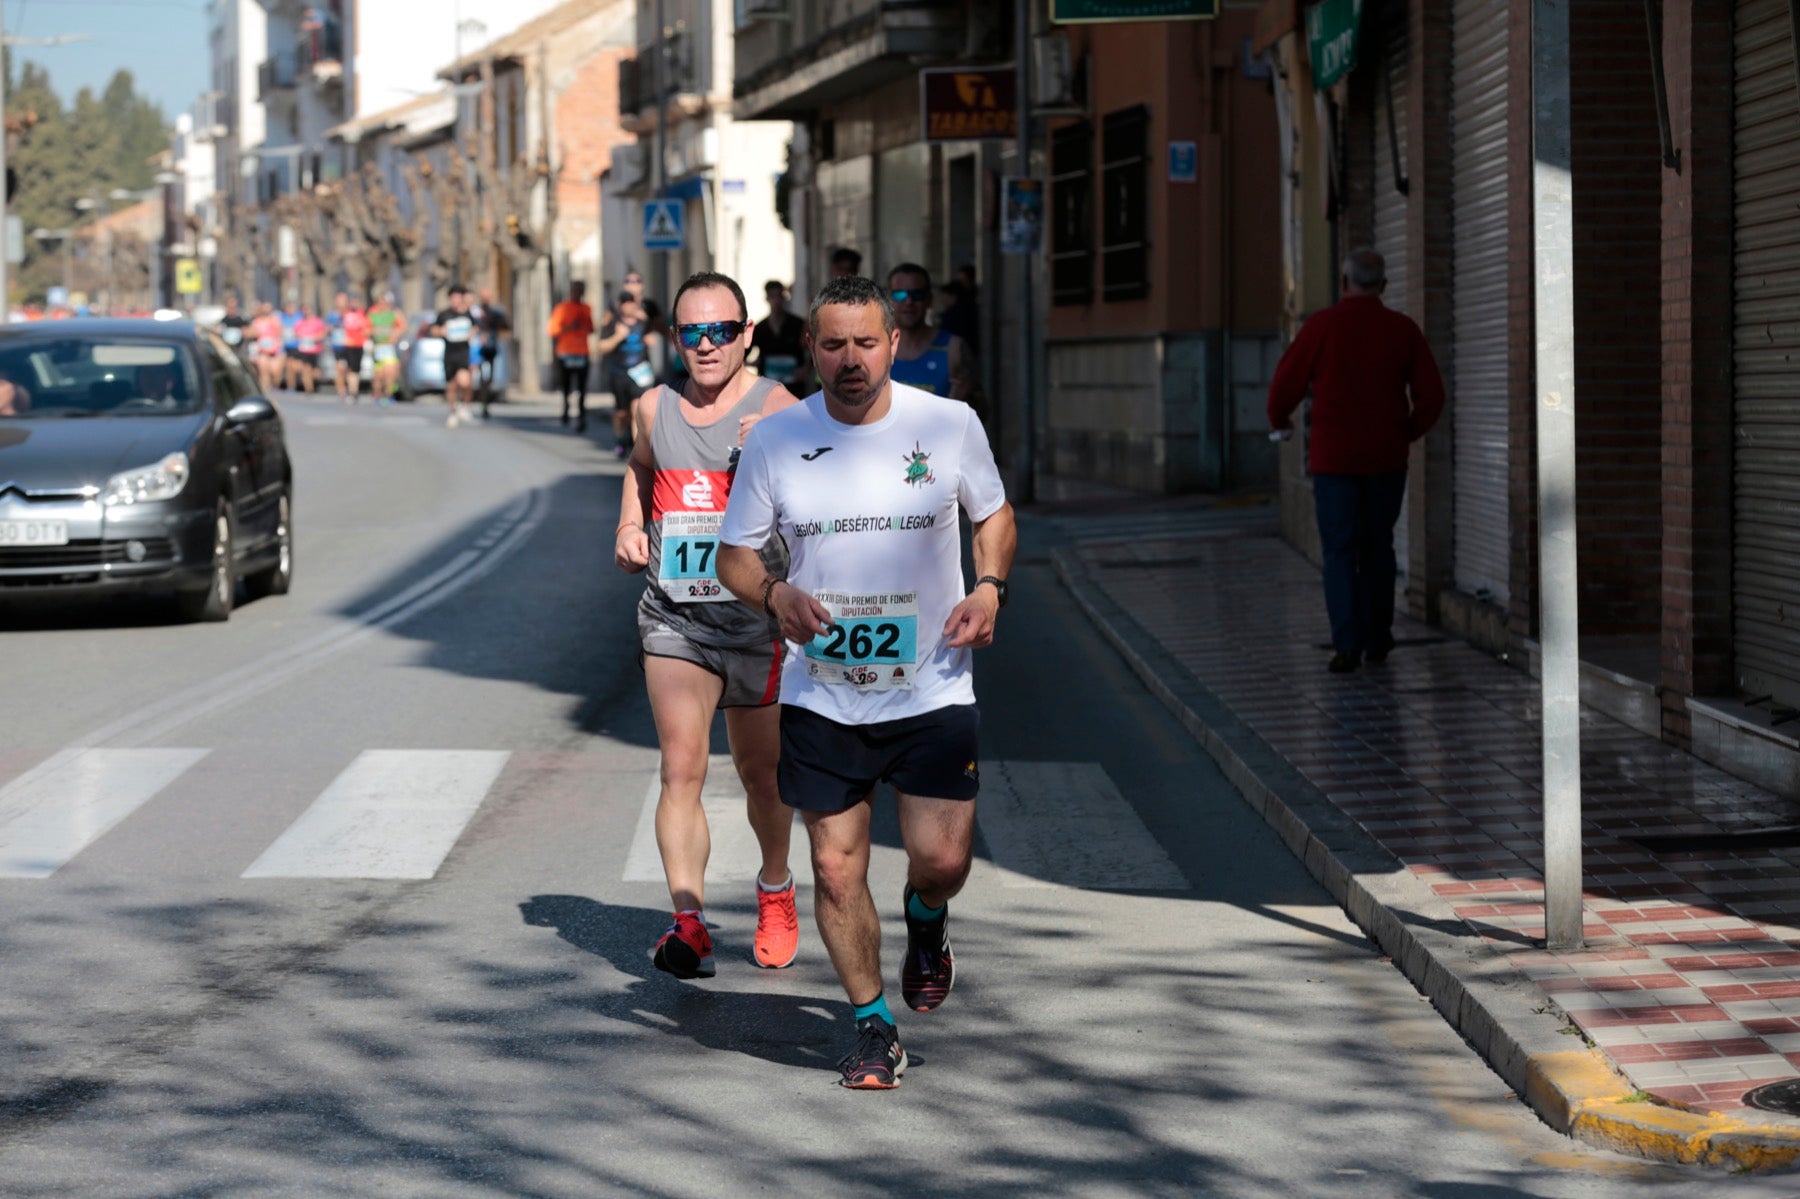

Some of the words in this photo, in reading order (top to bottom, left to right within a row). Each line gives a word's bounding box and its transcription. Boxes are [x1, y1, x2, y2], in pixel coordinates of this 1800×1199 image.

[696, 514, 718, 524] PREMIO
[676, 541, 715, 573] 17
[835, 594, 850, 605] GRAN
[851, 595, 878, 605] PREMIO
[879, 595, 889, 604] DE
[823, 623, 900, 660] 262
